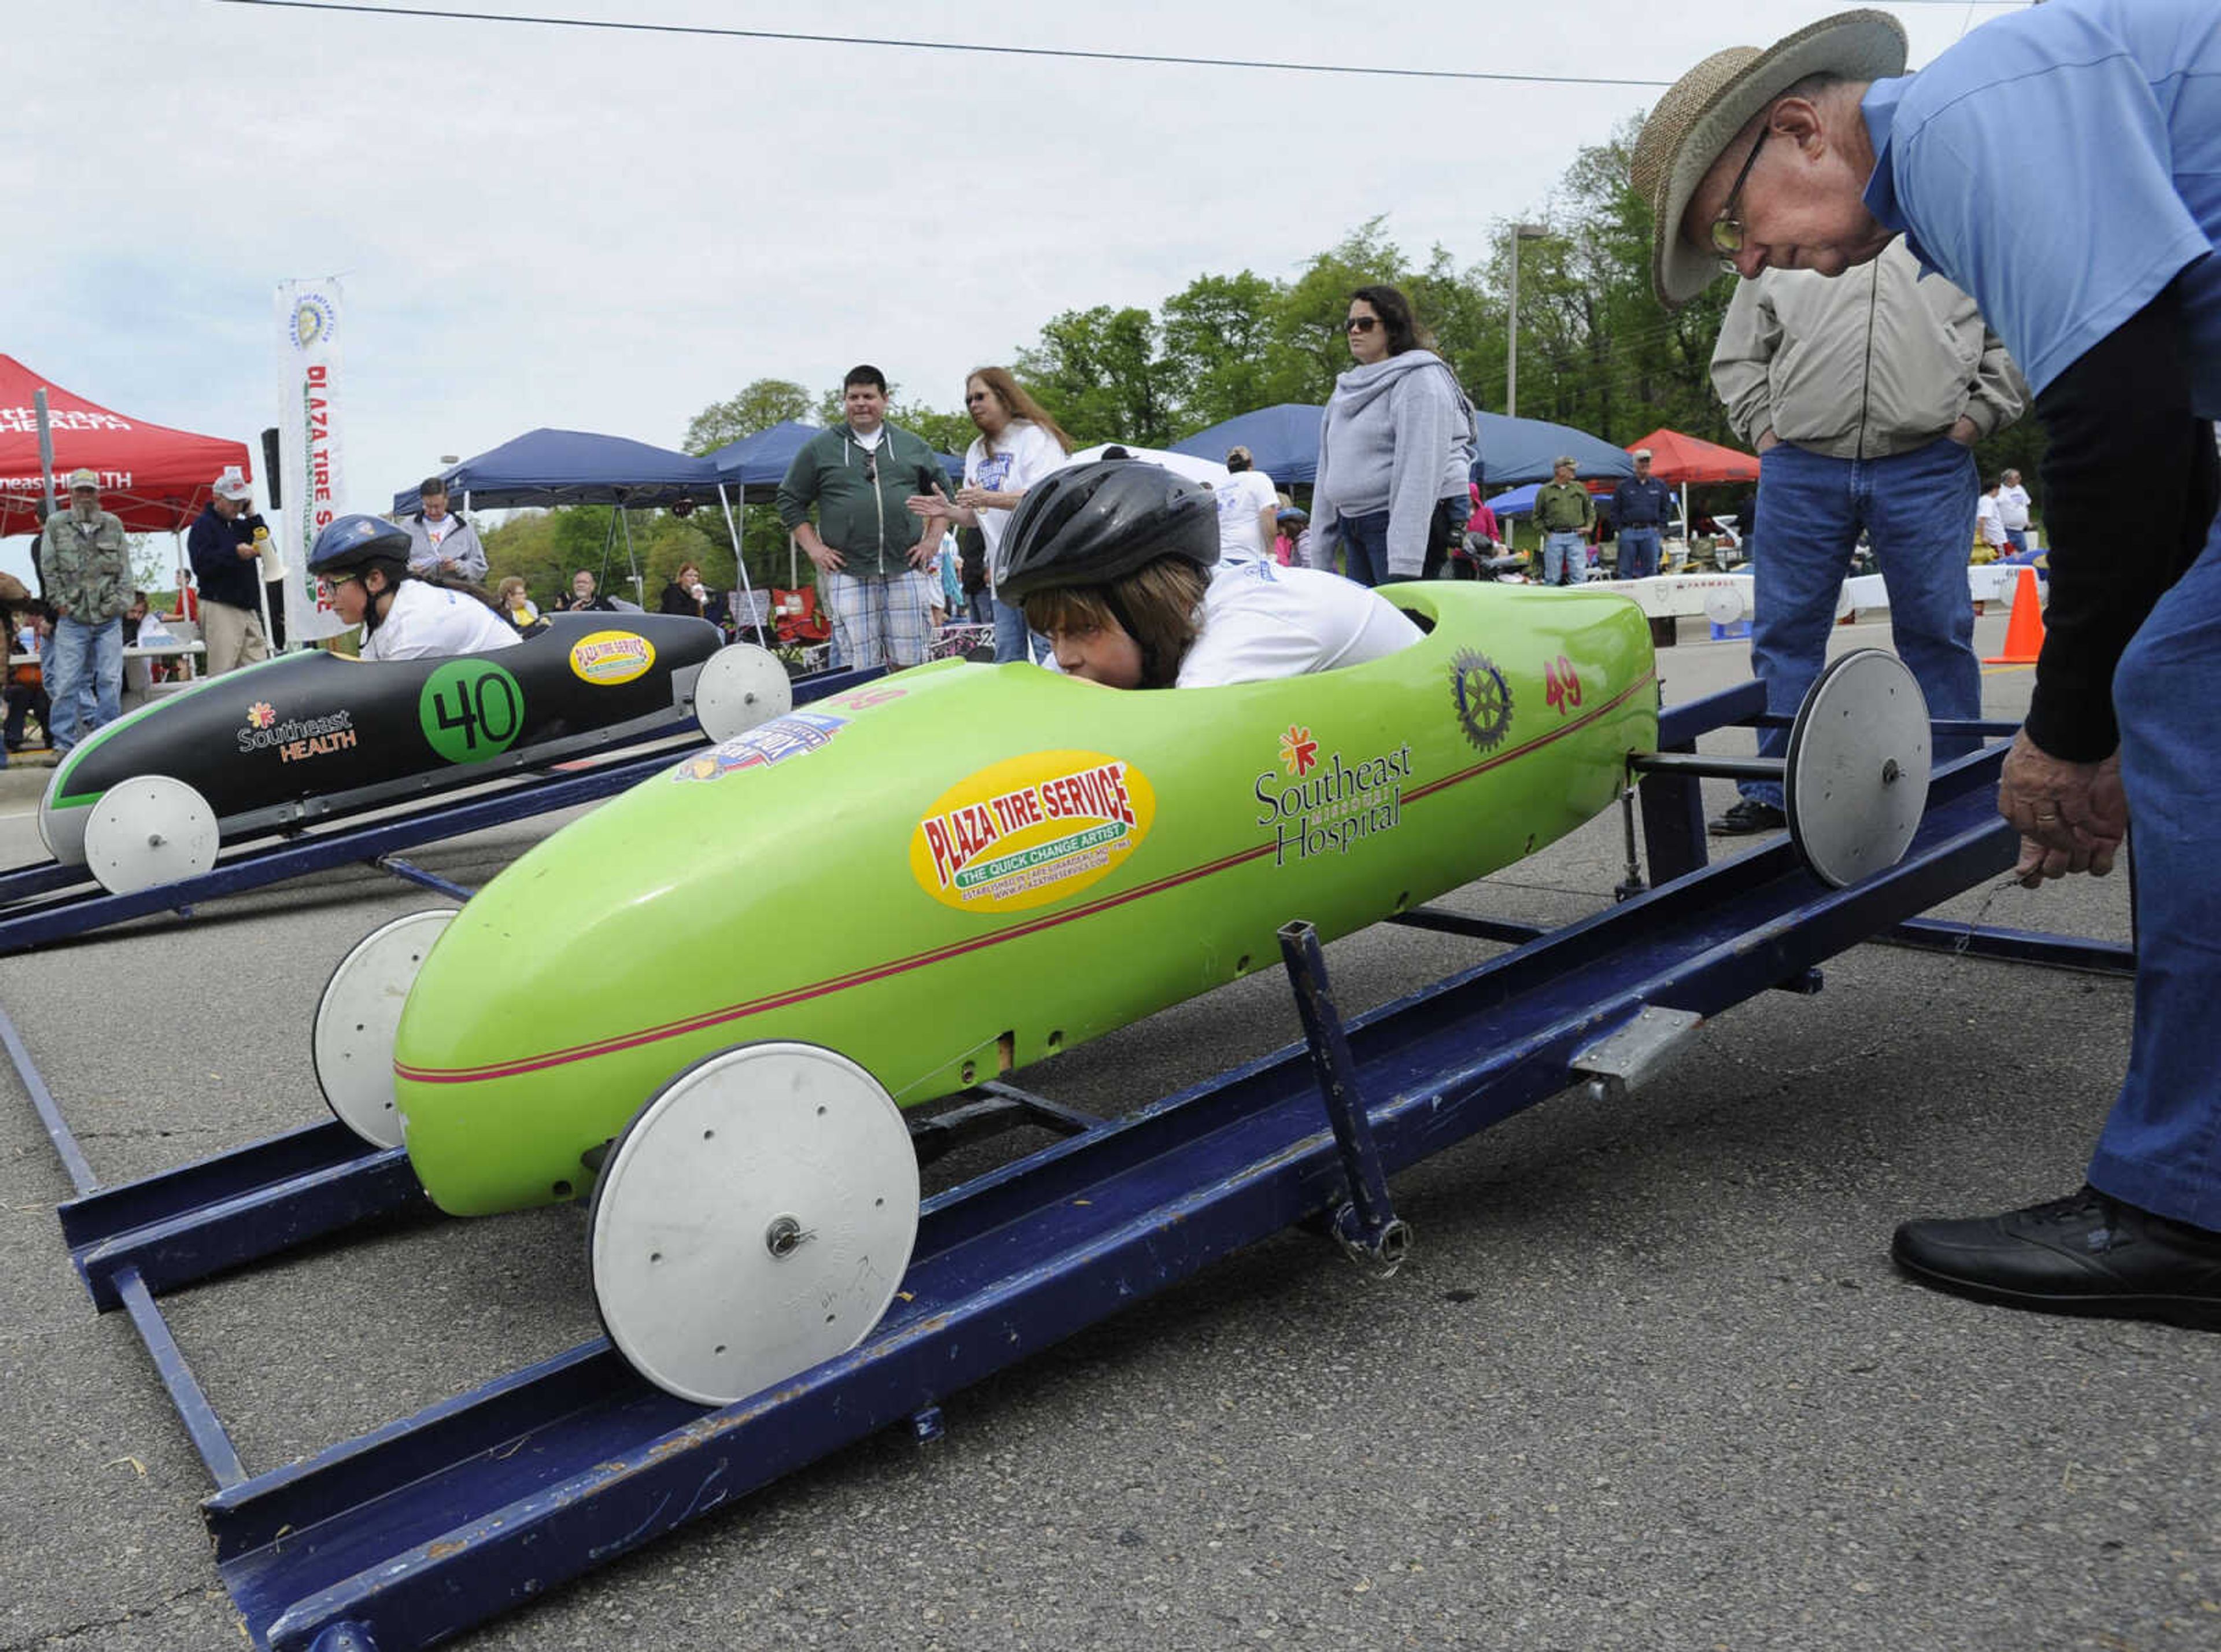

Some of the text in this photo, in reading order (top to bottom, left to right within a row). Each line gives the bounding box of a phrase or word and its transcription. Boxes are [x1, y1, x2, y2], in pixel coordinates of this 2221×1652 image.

[307, 366, 327, 441] PLAZA
[312, 448, 331, 502] TIRE
[433, 672, 516, 750] 40
[1544, 655, 1581, 716] 49
[238, 709, 352, 752] Southeast
[280, 729, 357, 763] HEALTH
[1255, 743, 1411, 825] Southeast
[924, 765, 1134, 886] PLAZA TIRE SERVICE
[962, 824, 1120, 884] THE QUICK CHANGE ARTIST
[1276, 784, 1400, 866] Hospital
